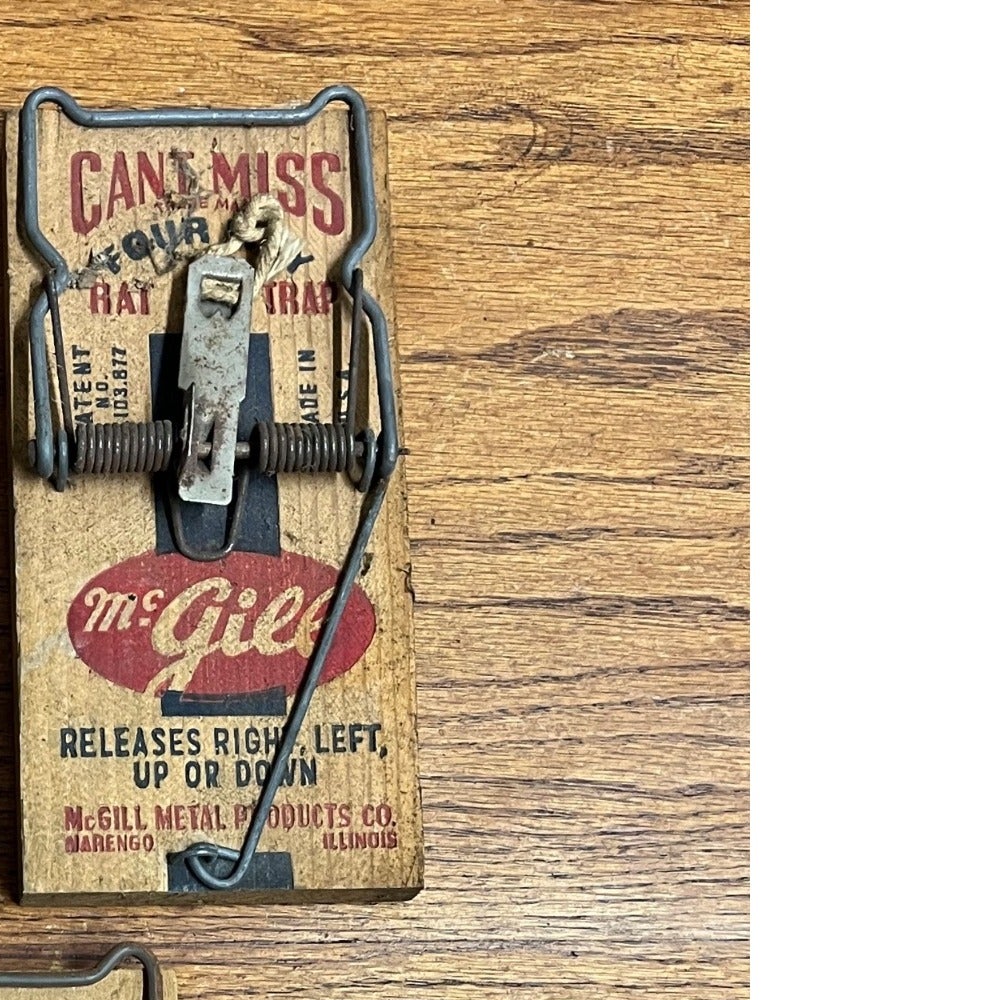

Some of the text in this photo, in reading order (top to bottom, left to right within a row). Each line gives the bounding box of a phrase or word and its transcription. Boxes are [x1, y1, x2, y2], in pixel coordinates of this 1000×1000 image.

[70, 149, 346, 236] CANT MISS
[101, 217, 209, 275] FOUR
[90, 280, 338, 315] RAT TRAP
[71, 344, 94, 424] ATENT
[298, 350, 320, 423] ADE IN
[60, 724, 388, 759] RELEASES RIGH, LEFT,
[133, 760, 169, 789] UP
[185, 760, 220, 788] OR
[64, 803, 397, 831] McGILL METAL PODUCTS CO.
[322, 831, 398, 850] ILLINOIS
